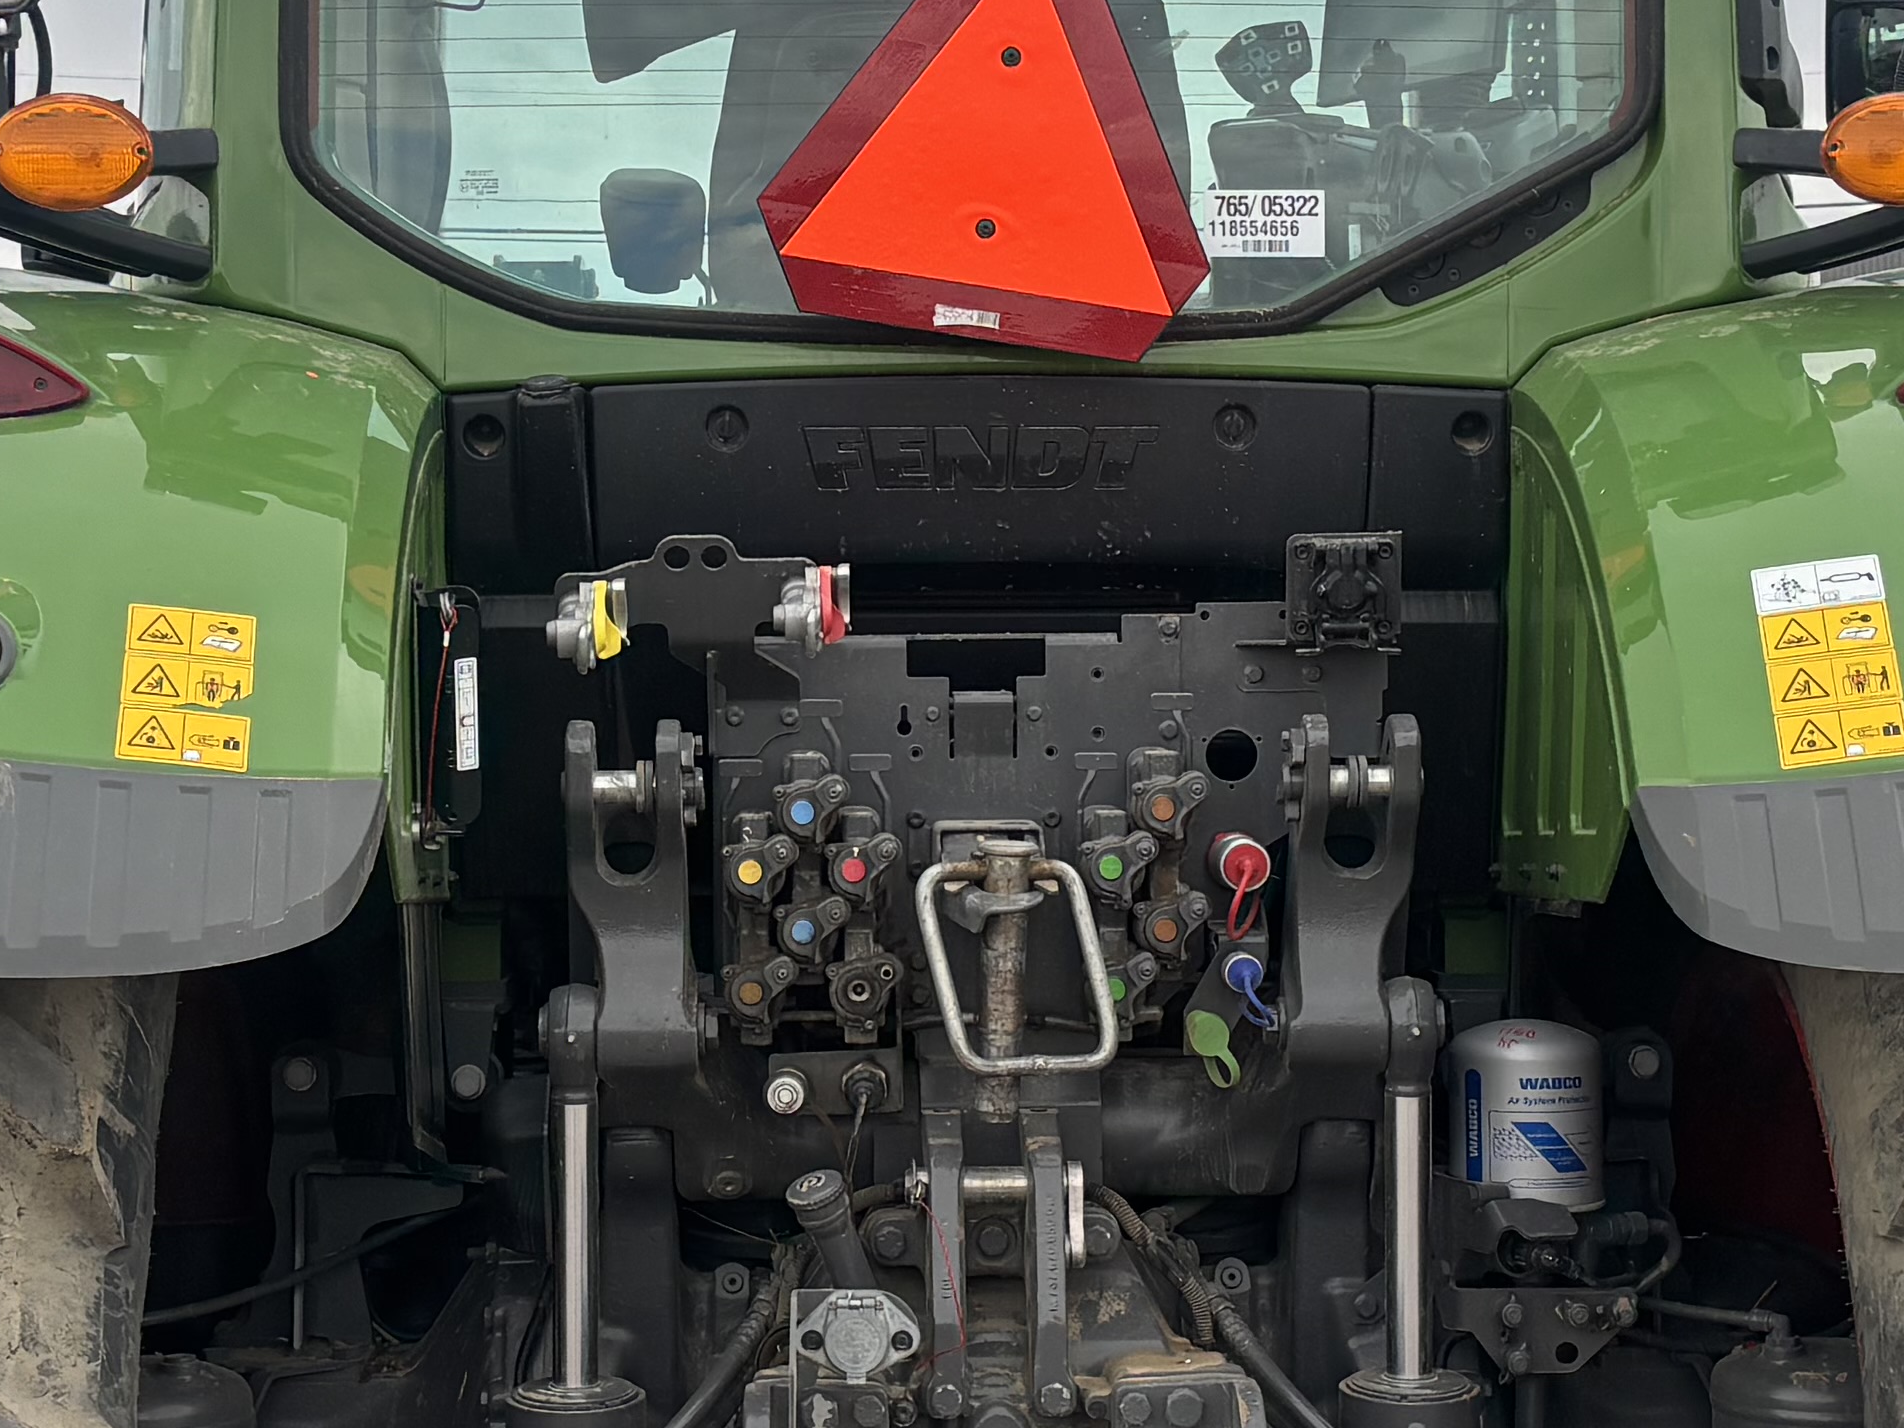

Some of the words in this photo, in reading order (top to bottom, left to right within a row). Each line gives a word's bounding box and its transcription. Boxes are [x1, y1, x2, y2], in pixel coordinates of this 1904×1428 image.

[1261, 195, 1319, 217] 05322
[1208, 220, 1300, 237] 118554656
[803, 425, 1160, 491] FENDT
[1519, 1076, 1582, 1090] WABCO
[1468, 1098, 1479, 1158] WABCO
